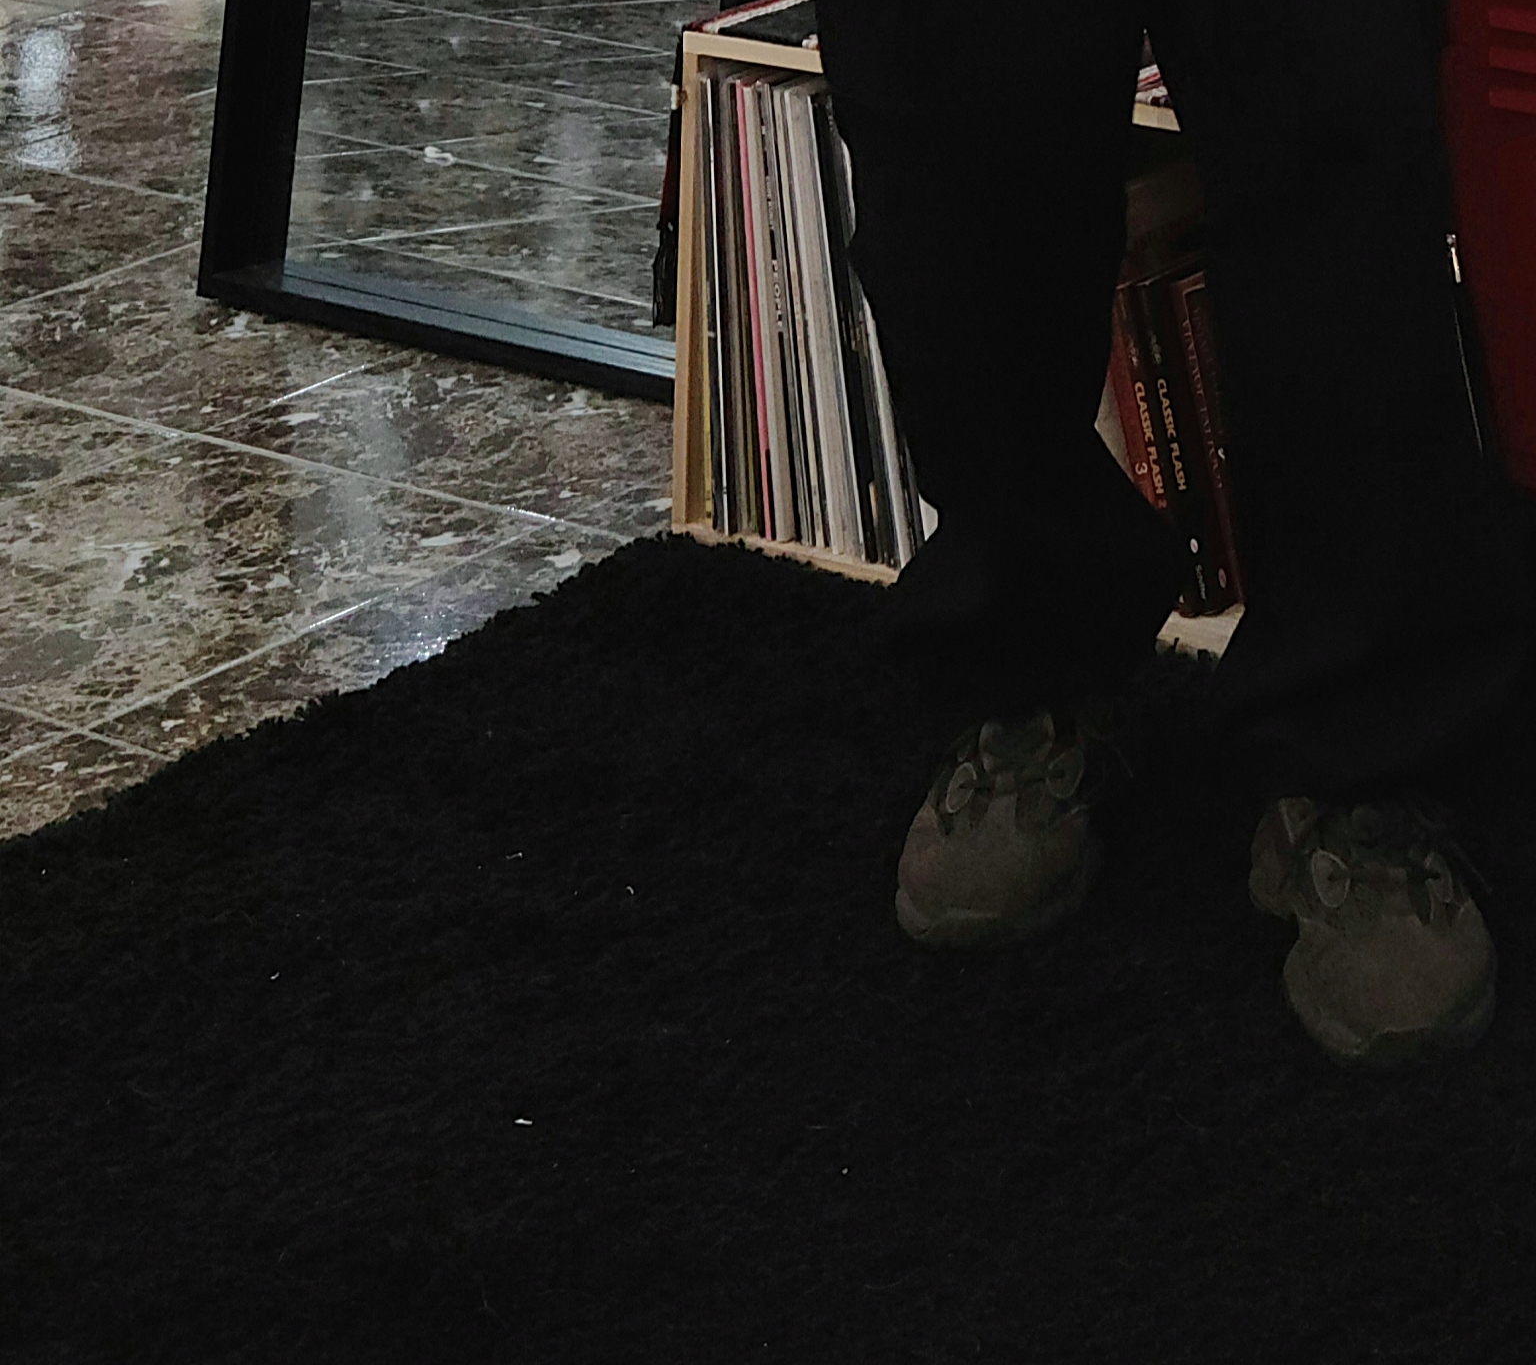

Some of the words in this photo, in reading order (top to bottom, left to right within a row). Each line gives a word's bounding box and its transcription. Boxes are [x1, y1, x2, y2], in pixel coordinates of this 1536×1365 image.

[1134, 380, 1155, 442] CLASSIC
[1146, 445, 1166, 494] FLASH
[1134, 460, 1149, 475] 3
[1156, 377, 1178, 438] CLASSIC
[1169, 441, 1188, 492] FLASH
